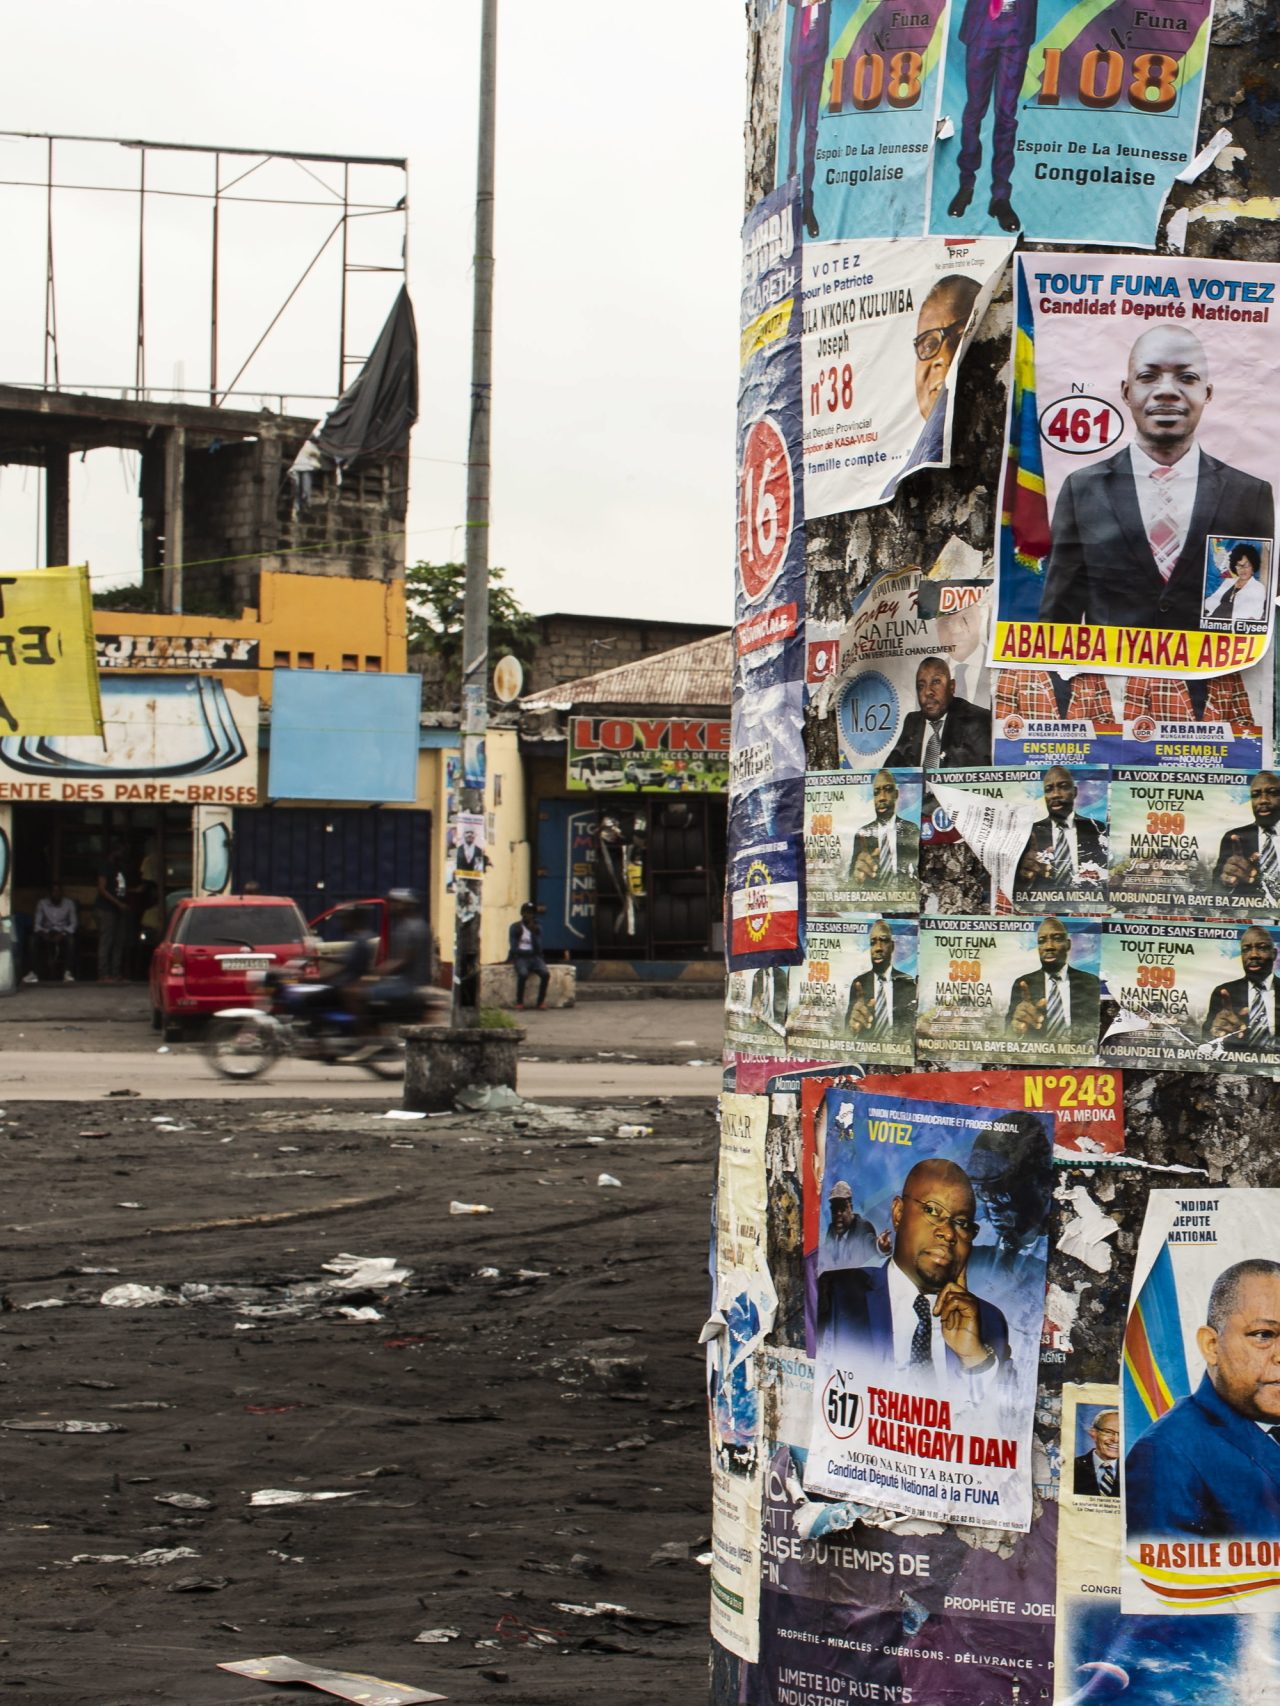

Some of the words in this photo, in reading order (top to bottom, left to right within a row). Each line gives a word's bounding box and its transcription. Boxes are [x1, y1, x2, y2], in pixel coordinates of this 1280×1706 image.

[890, 11, 930, 29] Funa
[1134, 11, 1188, 31] Funa
[829, 51, 923, 114] 108
[1036, 48, 1180, 113] 108
[845, 146, 858, 158] De
[861, 145, 875, 156] La
[878, 143, 928, 155] Jeunesse
[1017, 140, 1063, 154] Espoir
[1068, 143, 1088, 155] De
[1093, 144, 1113, 156] La
[1117, 146, 1188, 162] Jeunesse
[825, 165, 904, 186] Congolaise
[1035, 163, 1155, 186] Congolaise
[948, 249, 969, 258] PRP
[813, 255, 861, 276] VOTEZ
[801, 285, 821, 301] pour
[823, 284, 830, 295] le
[834, 274, 873, 292] Patriote
[1035, 273, 1103, 294] TOUT
[1111, 275, 1180, 297] FUNA
[1188, 279, 1275, 303] VOTEZ
[860, 288, 913, 319] KULUMBA
[1040, 298, 1115, 315] Candidat
[1122, 300, 1186, 319] Deputé
[1192, 304, 1269, 322] National
[818, 330, 849, 358] Joseph
[1048, 407, 1110, 444] 461
[808, 459, 840, 474] famille
[844, 451, 887, 467] compte
[886, 620, 928, 637] FUNA
[1236, 621, 1267, 633] Elysee
[877, 638, 903, 649] UTILE
[905, 645, 956, 656] CHANGEMENT
[1001, 624, 1107, 662] ABALABA
[1116, 629, 1189, 667] IYAKA
[1197, 635, 1257, 669] ABEL
[575, 719, 730, 750] LOYKE
[1028, 723, 1087, 732] KABAMPA
[1161, 725, 1224, 734] KABAMPA
[619, 751, 651, 760] VENTE
[654, 751, 689, 760] PIECES
[692, 752, 705, 760] DE
[1023, 742, 1090, 754] ENSEMBLE
[1044, 754, 1084, 762] NOUVEAU
[1155, 744, 1228, 756] ENSEMBLE
[1118, 772, 1131, 780] LA
[1134, 772, 1159, 781] VOIX
[1161, 773, 1175, 782] DE
[1177, 774, 1206, 783] SANS
[1207, 774, 1247, 785] EMPLOI
[62, 784, 104, 799] DES
[1130, 788, 1165, 799] TOUT
[1168, 789, 1204, 801] FUNA
[1147, 800, 1184, 811] VOTEZ
[1146, 813, 1185, 835] 399
[1131, 834, 1198, 849] MANENGA
[1130, 848, 1199, 860] MUNANGA
[1109, 892, 1171, 904] MOBUNDELI
[1173, 894, 1186, 905] YA
[1188, 895, 1213, 907] BAYE
[1216, 896, 1230, 907] BA
[1232, 897, 1270, 908] ZANGA
[1024, 1073, 1116, 1108] N°243
[912, 1113, 955, 1126] DEMOCRATIE
[965, 1119, 992, 1131] PROGES
[993, 1123, 1019, 1133] SOCIAL
[1056, 1110, 1072, 1122] YA
[1073, 1109, 1116, 1123] MBOKA
[868, 1120, 912, 1145] VOTEZ
[1173, 1216, 1211, 1227] DEPUTE
[1168, 1230, 1218, 1243] NATIONAL
[828, 1388, 858, 1428] 517
[867, 1386, 951, 1430] TSHANDA
[867, 1417, 962, 1463] KALENGAYI
[969, 1437, 1017, 1470] DAN
[847, 1451, 878, 1465] MOTO
[880, 1458, 893, 1470] NA
[895, 1462, 917, 1477] KATI
[920, 1467, 936, 1480] YA
[939, 1472, 973, 1486] BATO
[827, 1459, 867, 1481] Candidat
[869, 1468, 899, 1489] Député
[901, 1477, 938, 1498] National
[940, 1486, 947, 1500] à
[949, 1489, 961, 1501] la
[965, 1488, 1000, 1505] FUNA
[830, 1546, 894, 1575] TEMPS
[899, 1554, 930, 1577] DE
[1140, 1542, 1221, 1569] BASILE
[828, 1637, 872, 1653] MIRACLES
[883, 1646, 944, 1661] GUÉRISONS
[954, 1652, 1033, 1669] DÉLIVRANCE
[778, 1667, 823, 1691] LIMETE
[849, 1680, 880, 1700] RUE
[884, 1685, 913, 1704] N°5
